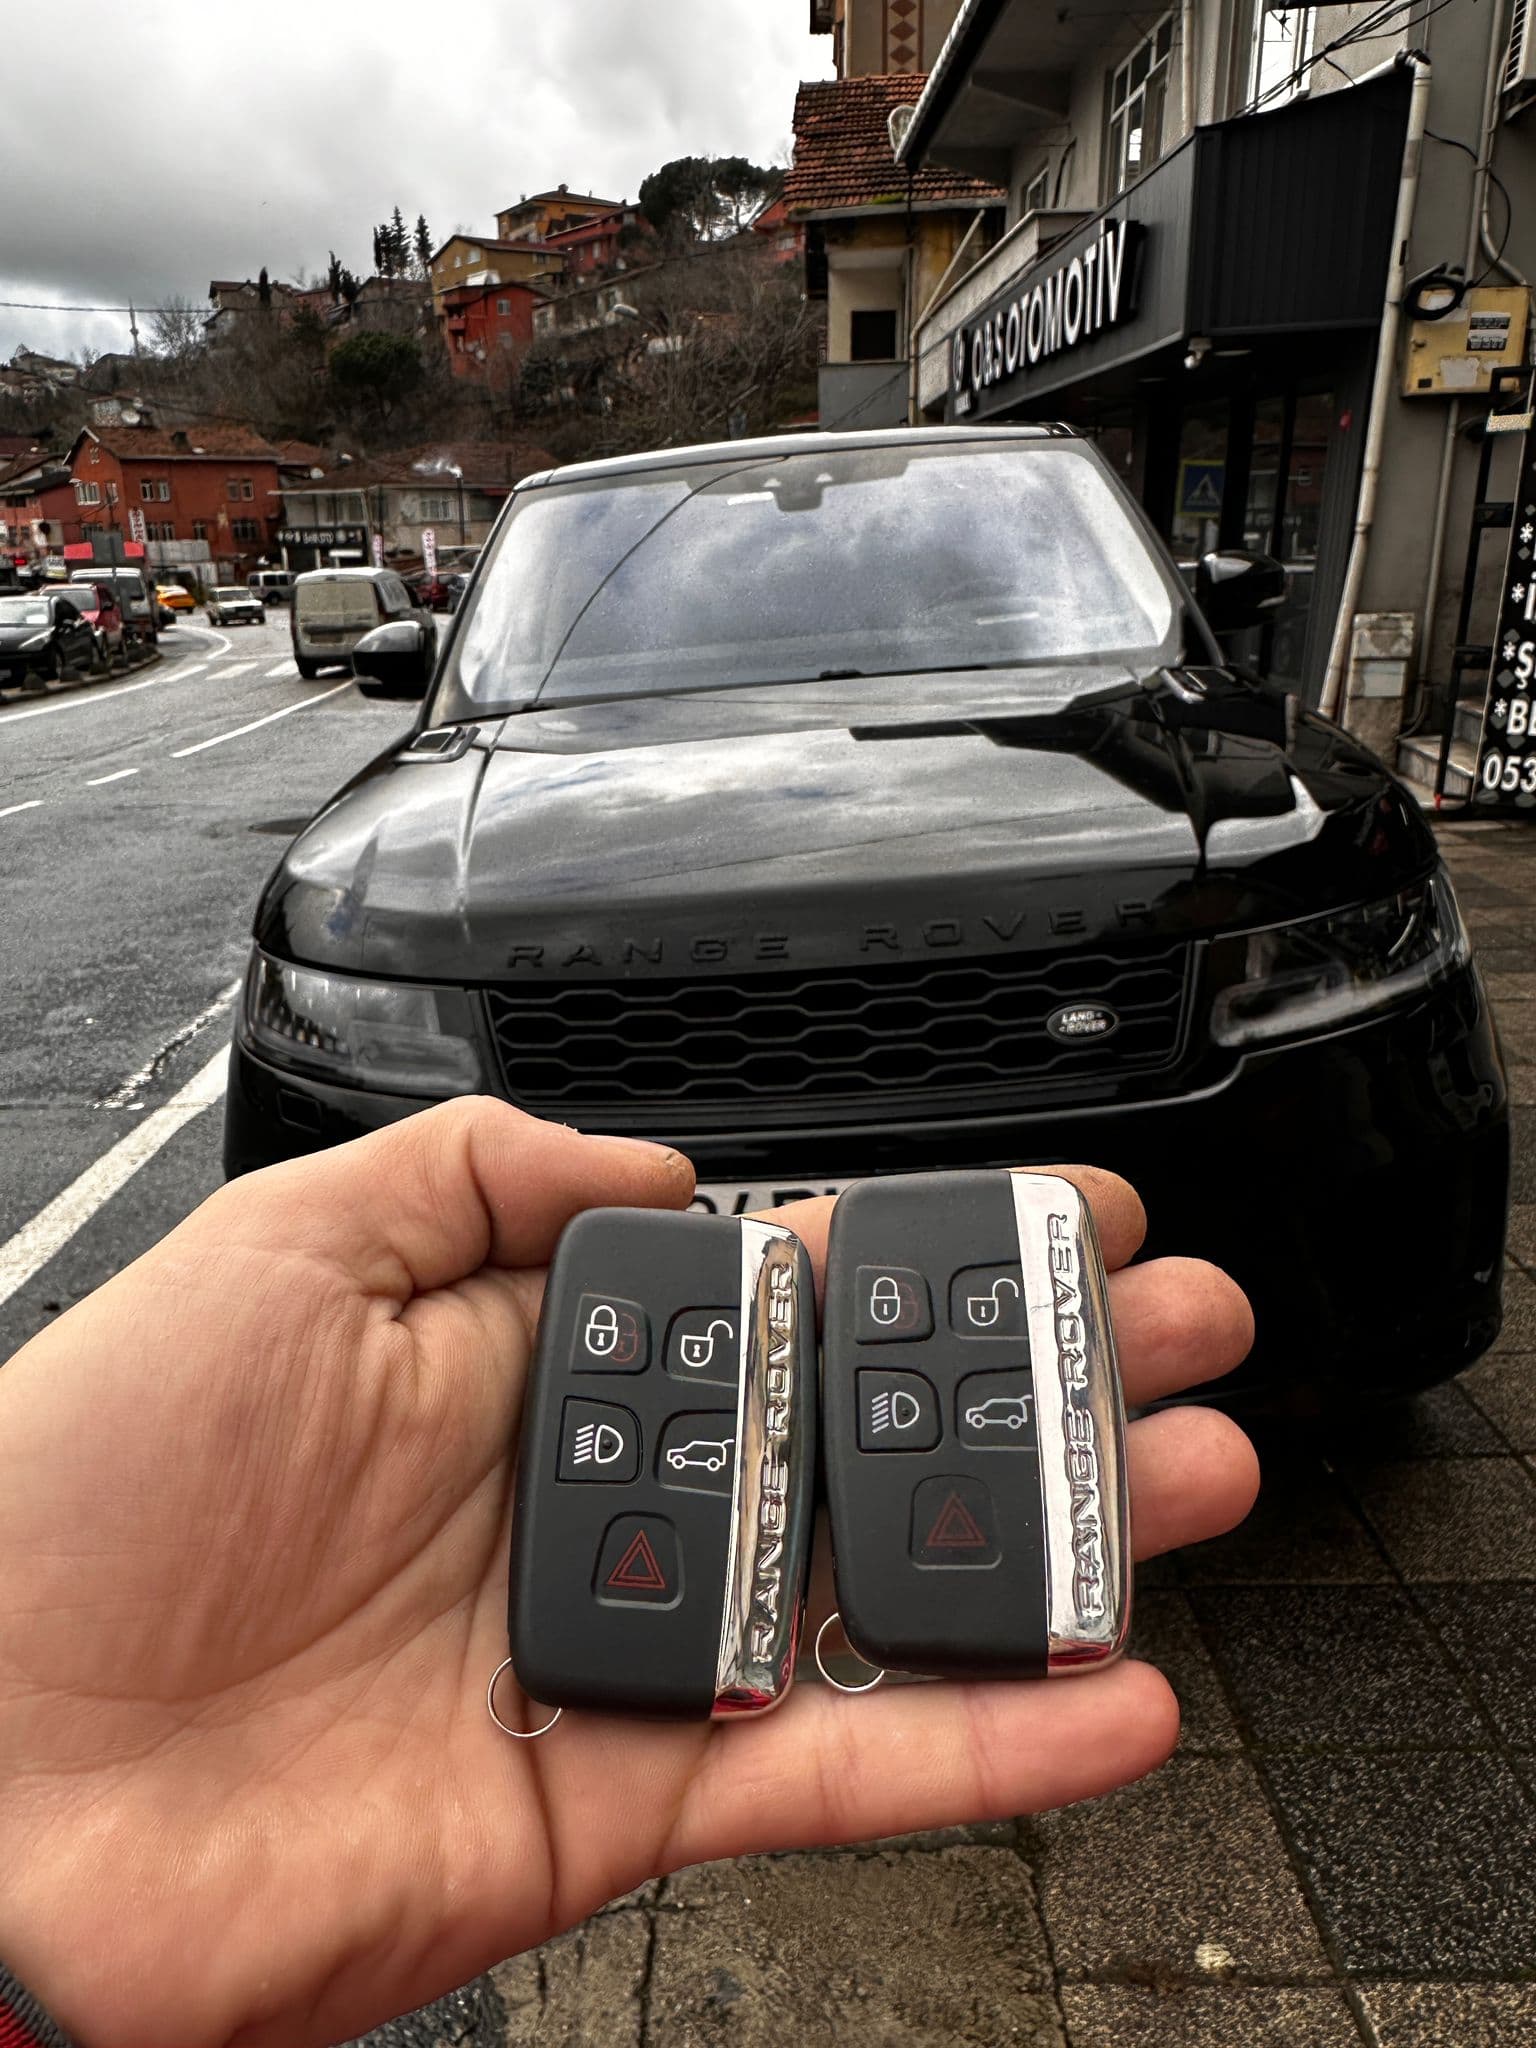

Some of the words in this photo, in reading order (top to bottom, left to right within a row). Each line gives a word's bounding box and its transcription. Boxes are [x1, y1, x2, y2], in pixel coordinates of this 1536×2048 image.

[506, 935, 791, 969] RANGE
[860, 899, 1157, 952] ROVER
[766, 1262, 794, 1437] ROVER
[1047, 1212, 1087, 1389] ROVER
[750, 1458, 789, 1665] RANGE
[1065, 1407, 1105, 1618] RANGE
